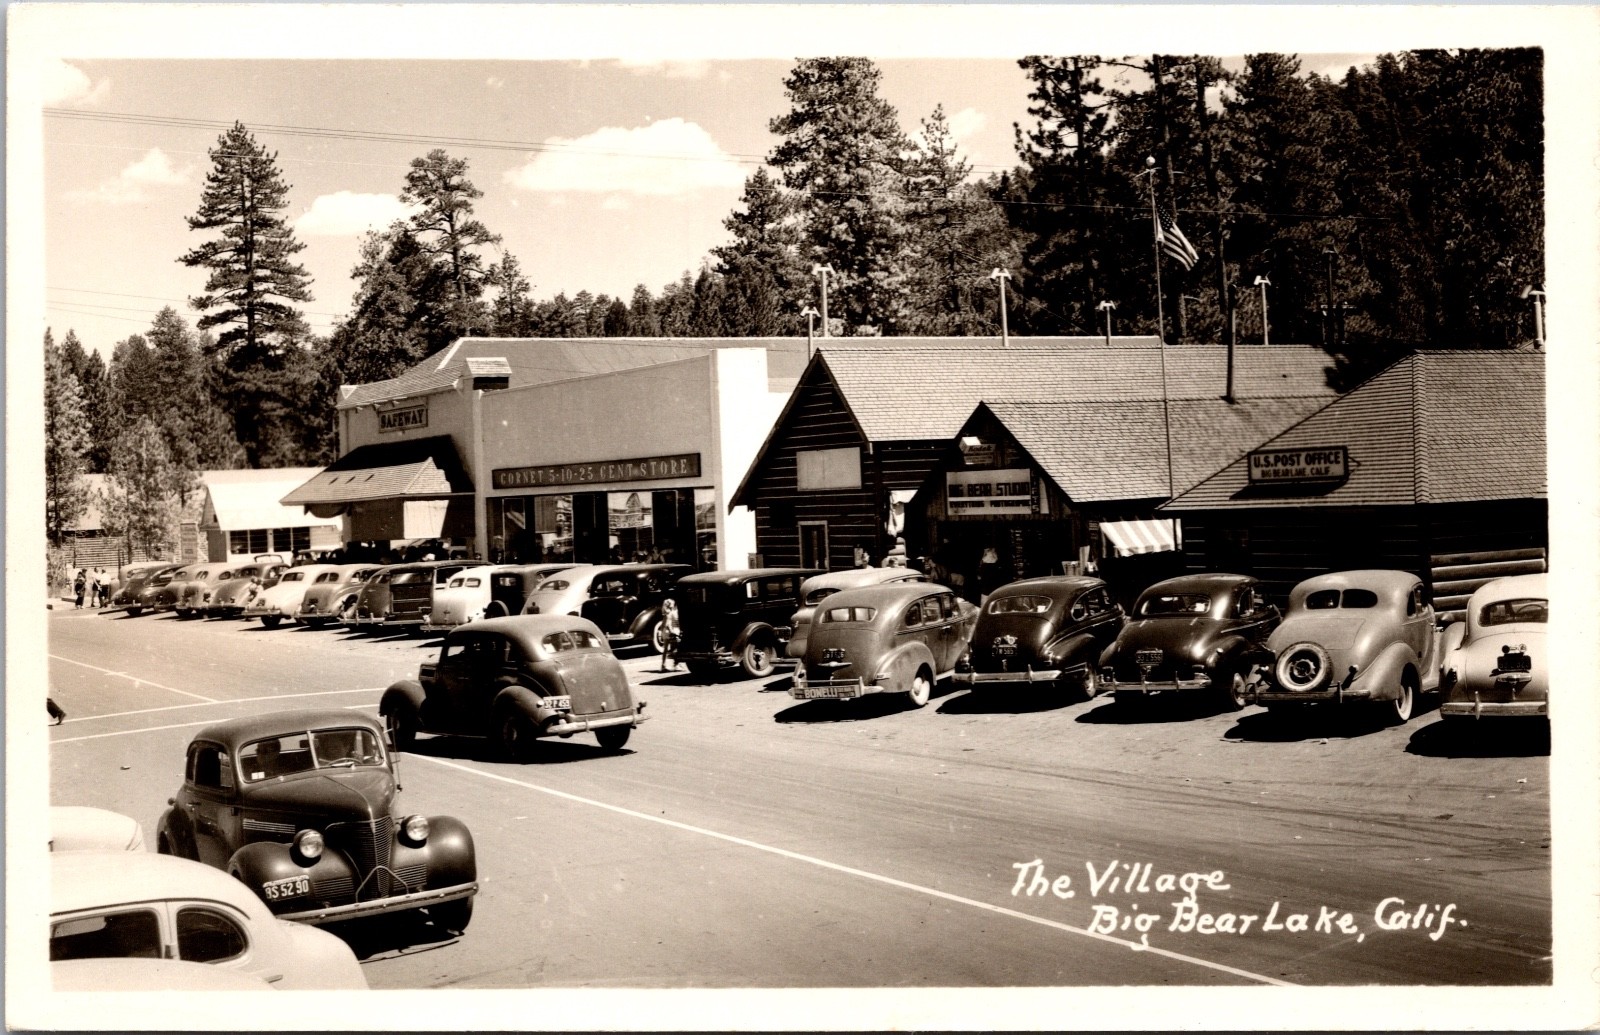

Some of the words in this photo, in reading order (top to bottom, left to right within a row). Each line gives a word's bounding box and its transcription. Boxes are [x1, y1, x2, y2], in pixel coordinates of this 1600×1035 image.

[381, 409, 424, 429] SAFEWAY
[1305, 451, 1341, 465] OFFICE
[500, 470, 544, 485] CORNET
[600, 463, 633, 480] CENT
[640, 458, 688, 477] STORE
[996, 482, 1030, 496] STUDIO
[804, 687, 838, 699] BONELLI
[281, 884, 294, 897] 52
[296, 880, 309, 893] 90
